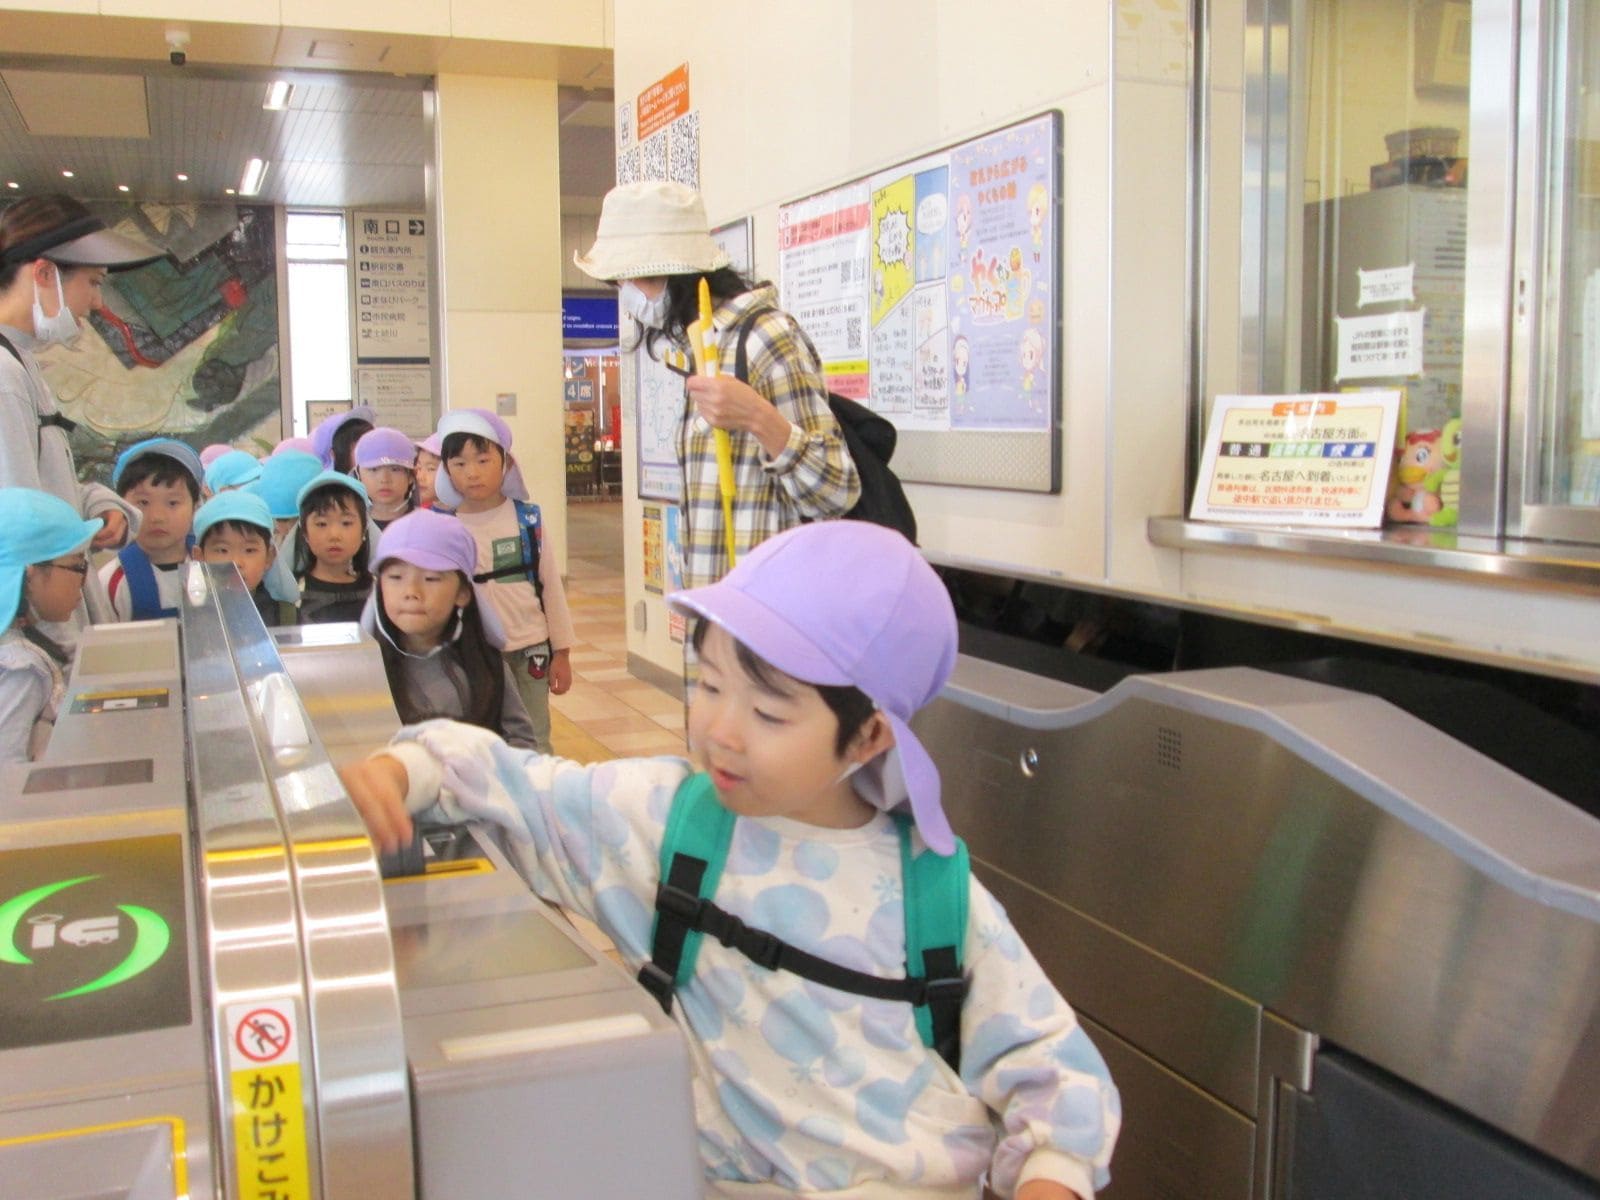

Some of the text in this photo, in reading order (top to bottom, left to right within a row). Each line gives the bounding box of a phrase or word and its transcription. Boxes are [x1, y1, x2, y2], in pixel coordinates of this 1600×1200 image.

[364, 219, 400, 234] 南口
[248, 1073, 291, 1200] かけこ
